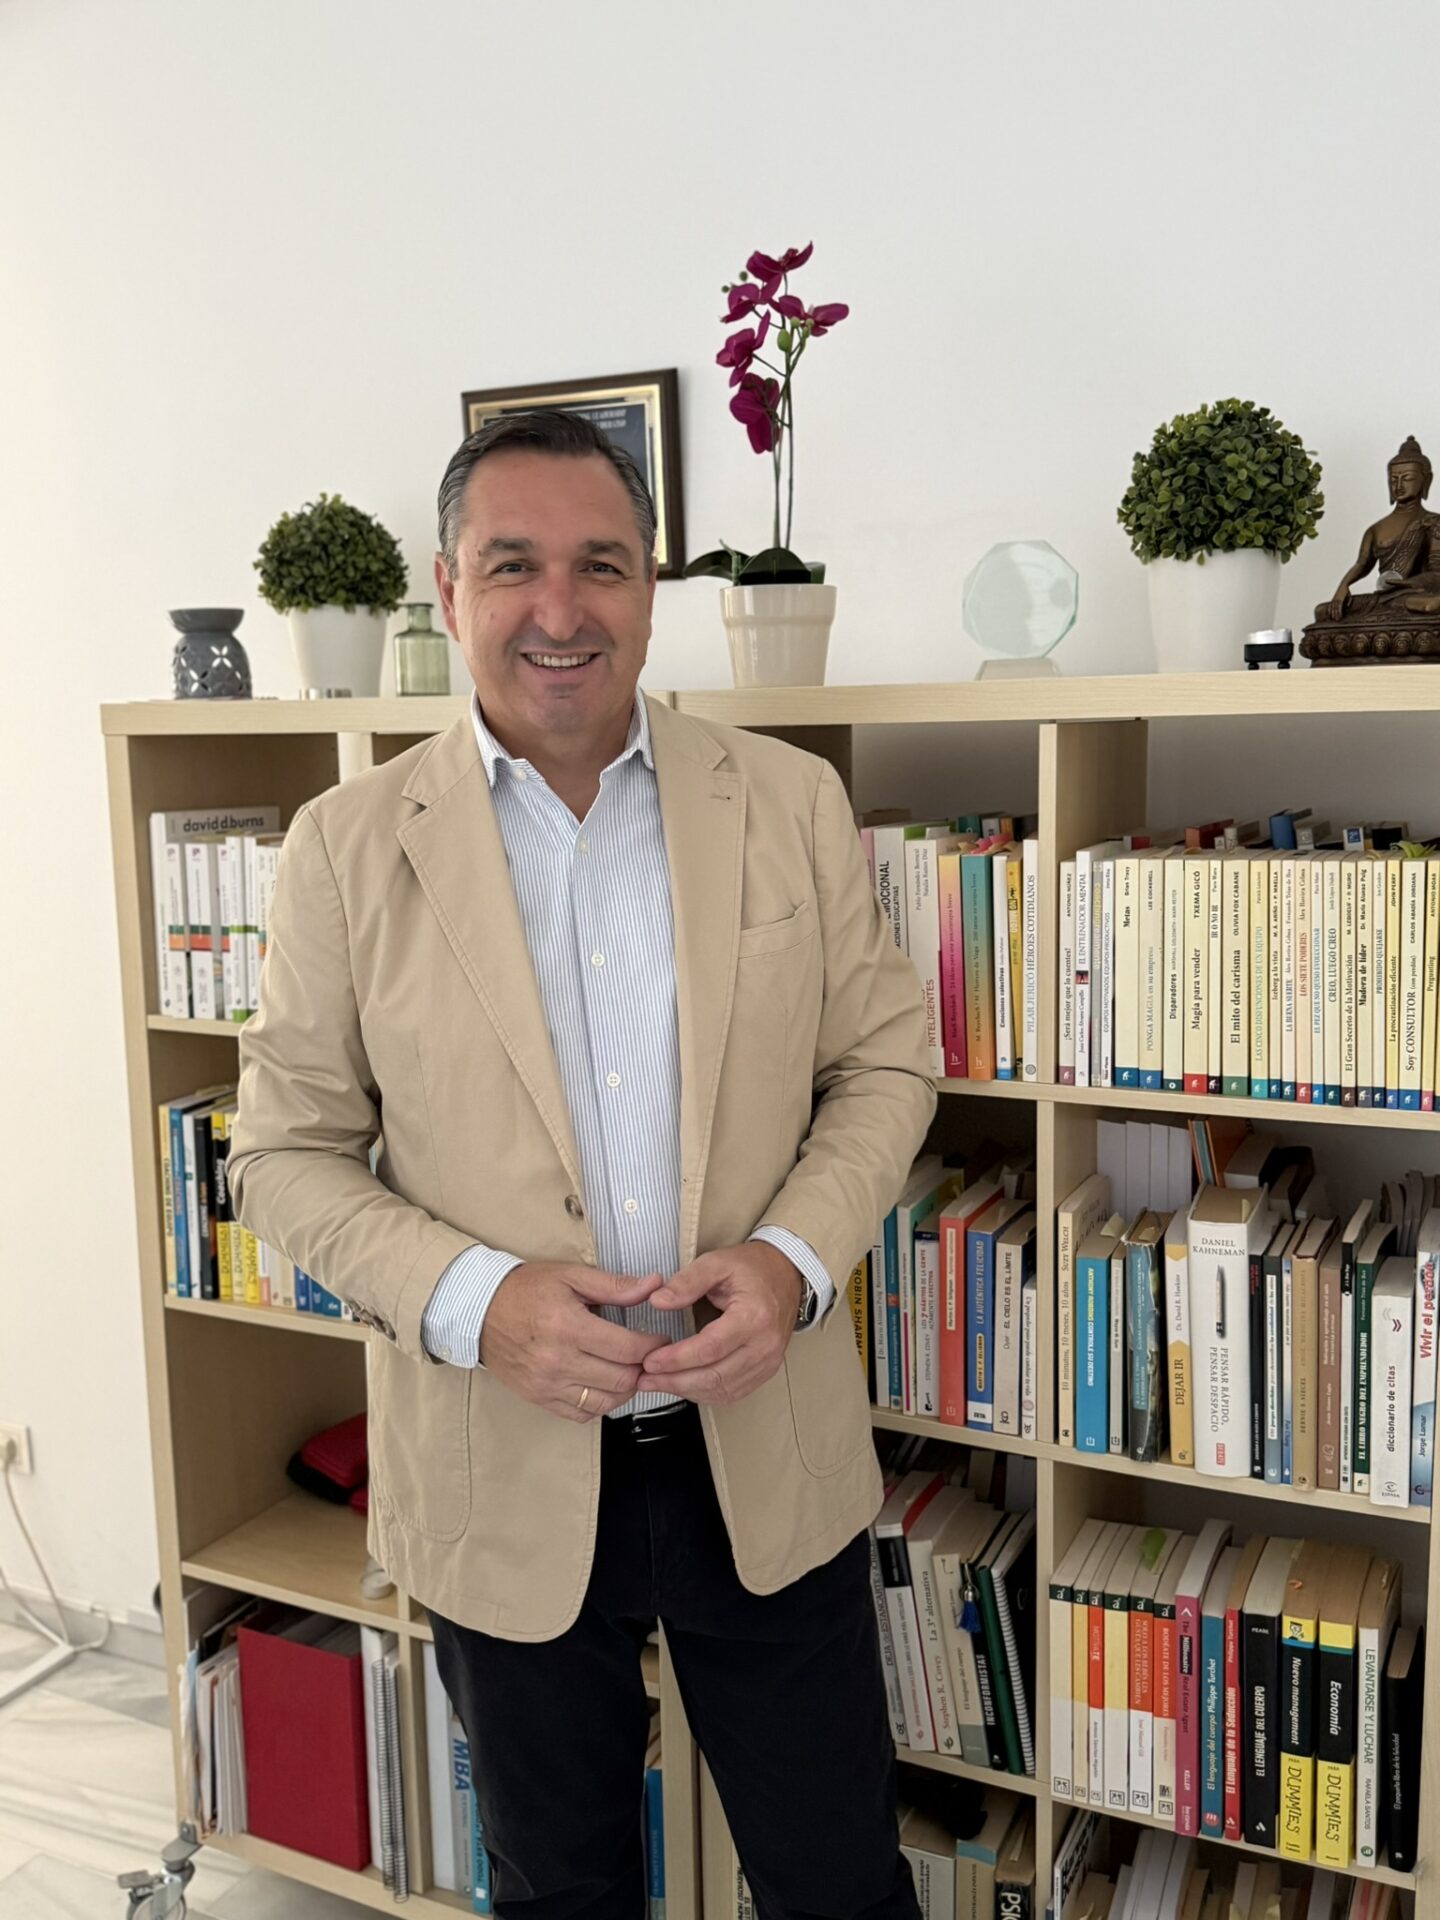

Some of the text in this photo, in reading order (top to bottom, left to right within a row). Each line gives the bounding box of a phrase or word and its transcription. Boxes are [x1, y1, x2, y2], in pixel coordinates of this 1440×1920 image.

[879, 861, 890, 919] MOCIONAL
[1192, 871, 1200, 890] GICÓ
[1123, 906, 1131, 928] Metas
[1025, 875, 1035, 1033] PILAR JERICÓ HÉROES COTIDIANOS
[1328, 929, 1338, 1003] CREO, LUEGO CREO
[1427, 956, 1436, 992] Pregunting
[1192, 948, 1203, 1030] Magia para vender
[1272, 978, 1280, 1000] Iceberg
[1345, 955, 1353, 996] Motivación
[1359, 944, 1367, 1007] Madera de líder
[926, 980, 936, 1047] INTELIGENTES
[1064, 1001, 1073, 1021] mejor
[1146, 946, 1156, 1051] PONGA MAGIA en su empresa
[1169, 974, 1179, 1019] Disparadores
[1231, 950, 1240, 1044] El mito del carisma
[1345, 1007, 1353, 1015] de
[1389, 984, 1398, 1033] procrastinación
[1345, 1016, 1353, 1043] Secreto
[1389, 1034, 1396, 1042] La
[1406, 992, 1417, 1071] Soy CONSULTOR
[1345, 1044, 1353, 1063] Gran
[1345, 1064, 1353, 1072] El
[216, 1159, 226, 1204] Coaching
[1003, 1252, 1012, 1274] LÍMITE
[1192, 1246, 1246, 1257] KAHNEMAN
[1201, 1237, 1237, 1249] DANIEL
[854, 1269, 863, 1305] ROBIN
[975, 1242, 984, 1324] LA AUTÉNTICA FELICIDAD
[1004, 1276, 1011, 1284] EL
[1004, 1287, 1011, 1297] ES
[1004, 1320, 1011, 1329] EL
[1062, 1300, 1069, 1309] 10
[1063, 1312, 1071, 1336] meses,
[1420, 1310, 1433, 1325] el
[1062, 1338, 1069, 1347] 10
[1420, 1328, 1432, 1358] Vivir
[1062, 1349, 1071, 1380] minutos,
[1174, 1358, 1185, 1405] DEJAR IR
[1062, 1382, 1069, 1391] 10
[1209, 1346, 1218, 1432] PENSAR DESPACIO
[1219, 1348, 1231, 1426] PENSAR RÁPIDO,
[1358, 1332, 1367, 1459] EL LIBRO NEGRO DEL EMPRENDEDOR
[1387, 1366, 1395, 1452] diccionario de citas
[1418, 1439, 1428, 1456] Jorge
[921, 1571, 934, 1616] alternativa
[928, 1631, 938, 1641] La
[934, 1655, 953, 1729] Stephen R. Covey
[976, 1654, 996, 1725] INCONFORMISTAS
[1255, 1686, 1265, 1716] CUERPO
[1289, 1657, 1301, 1744] Nuevo management
[1330, 1680, 1341, 1735] Economía
[1364, 1648, 1375, 1763] LEVANTARSE Y LUCHAR
[1208, 1659, 1218, 1790] El lenguaje del cuerpo Philippe Turchet
[1226, 1687, 1238, 1794] El Lenguaje de la Seducción
[1256, 1718, 1265, 1730] DEL
[453, 1738, 470, 1791] MBA
[1256, 1731, 1265, 1767] LENGUAJE
[1286, 1766, 1302, 1834] DUMMIES
[1325, 1774, 1341, 1843] DUMMIES
